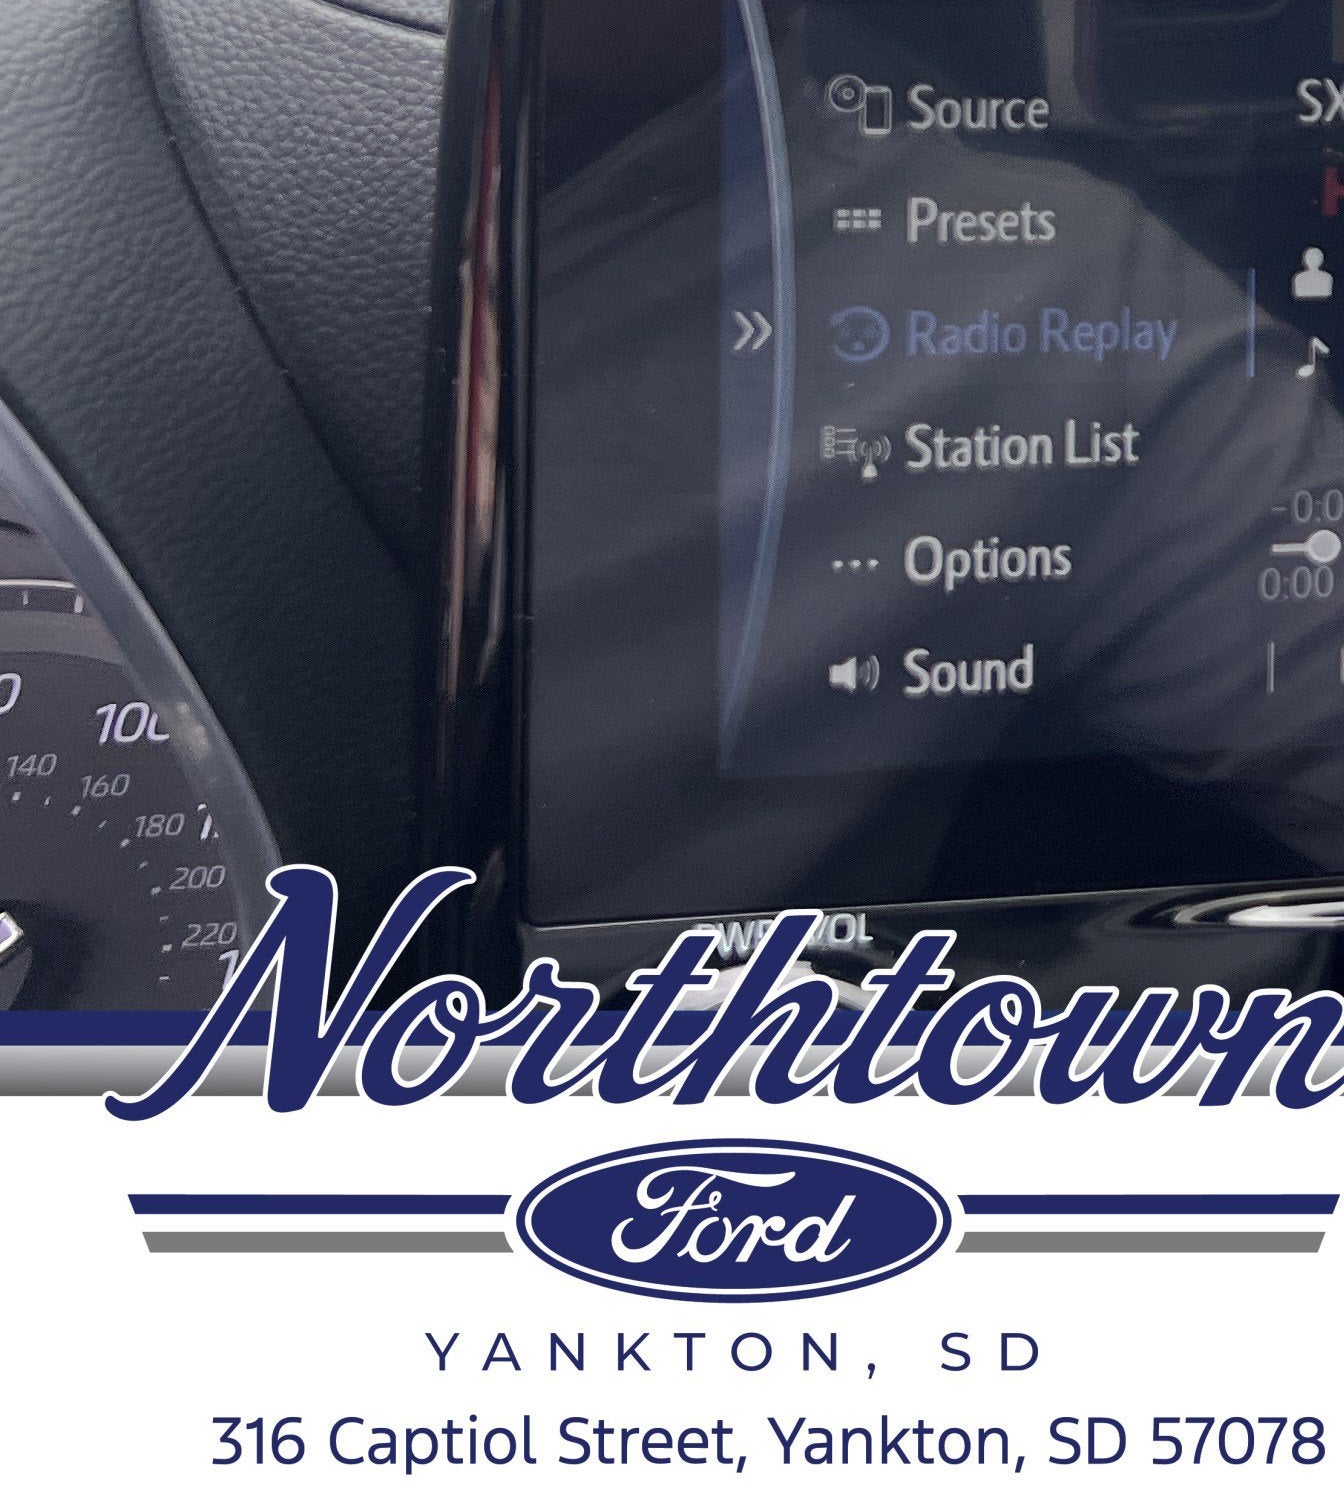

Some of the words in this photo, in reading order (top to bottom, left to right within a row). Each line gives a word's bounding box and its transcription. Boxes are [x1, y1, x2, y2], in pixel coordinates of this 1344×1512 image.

[907, 84, 1050, 131] Source
[906, 196, 1057, 244] Presets
[907, 307, 1028, 356] Radio
[1039, 306, 1179, 362] Replay
[904, 423, 1054, 470] Station
[1064, 418, 1141, 468] List
[904, 535, 1073, 593] Options
[1259, 565, 1335, 601] 0:00
[904, 642, 1035, 697] Sound
[7, 753, 58, 779] 140
[81, 773, 131, 798] 160
[134, 813, 185, 838] 180
[168, 864, 227, 891] 200
[180, 920, 239, 949] 220
